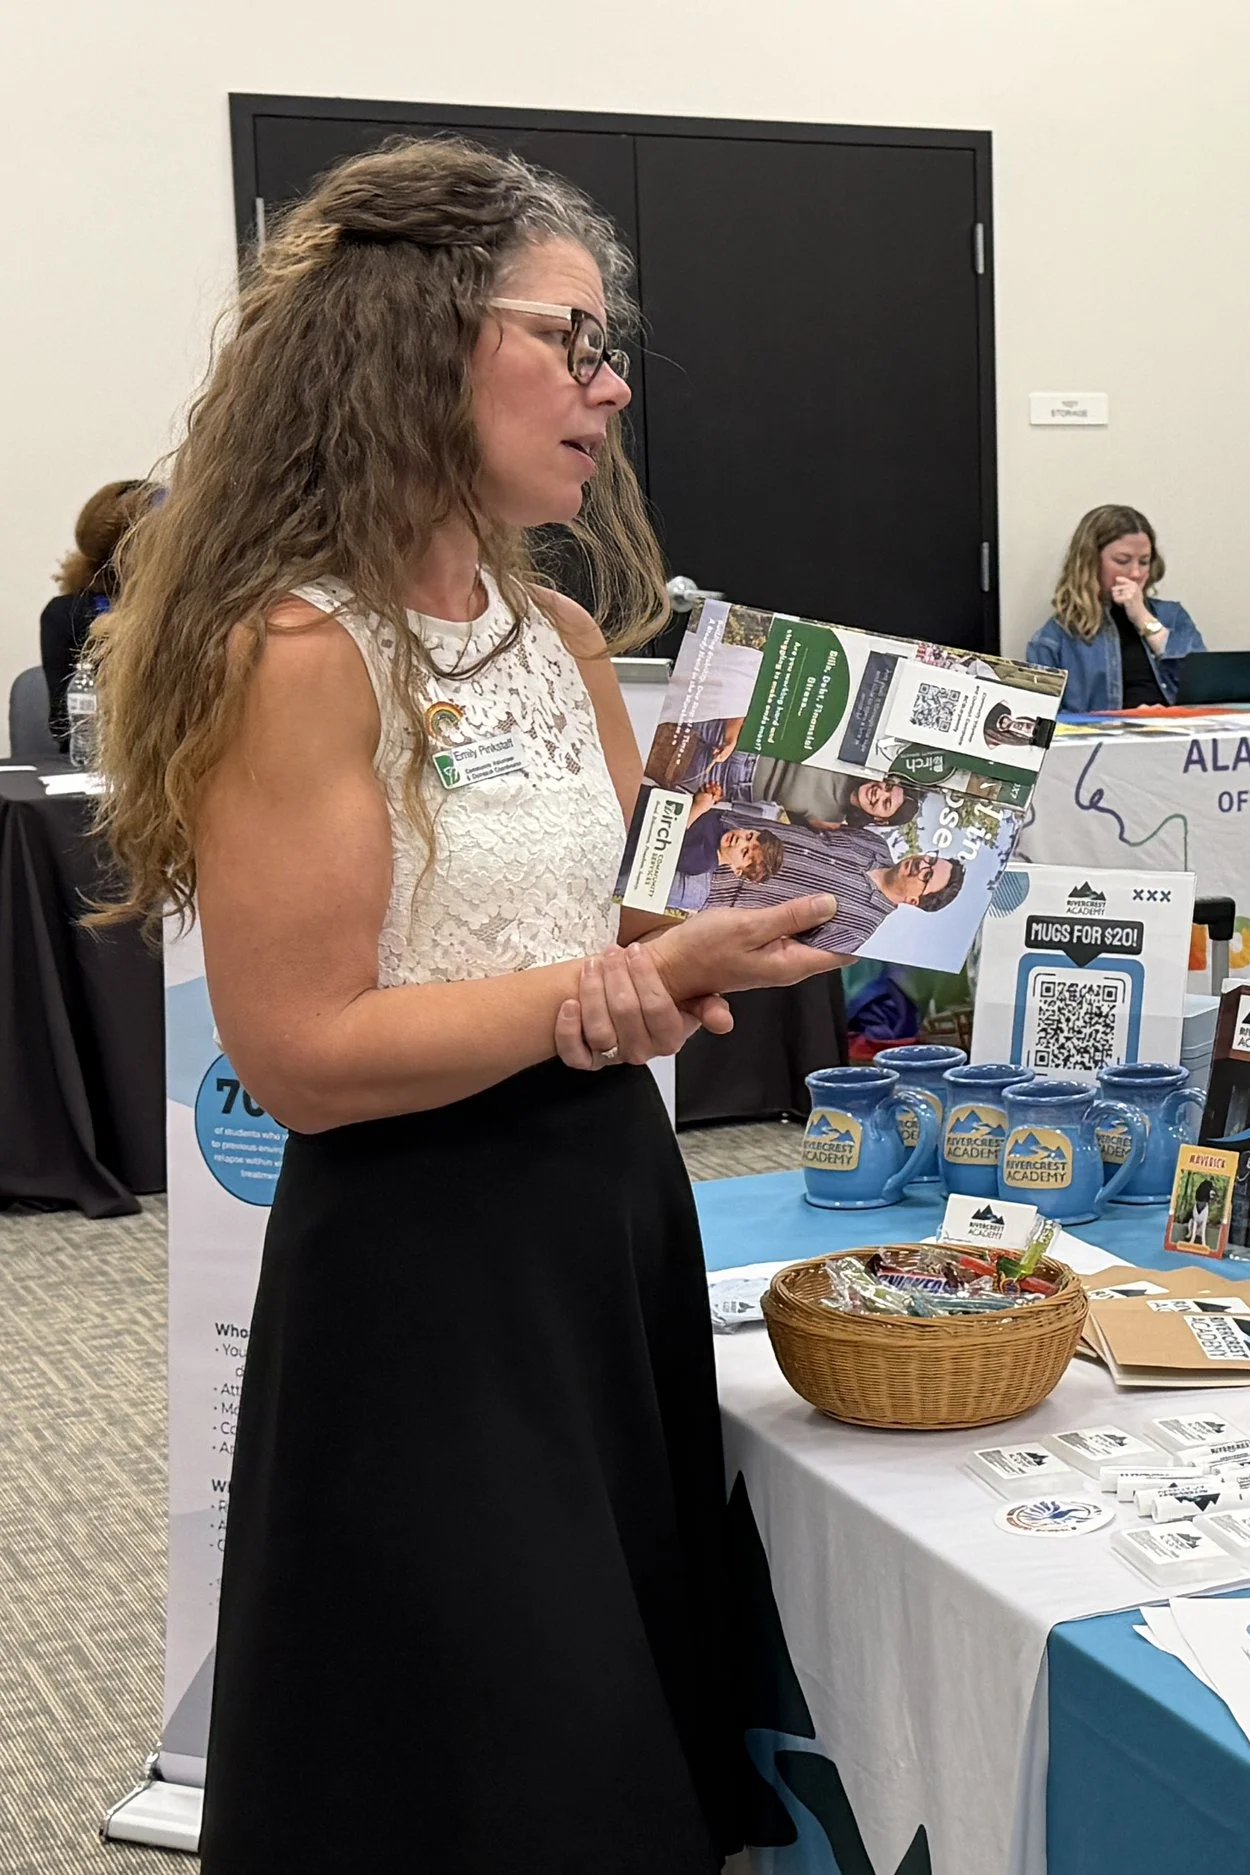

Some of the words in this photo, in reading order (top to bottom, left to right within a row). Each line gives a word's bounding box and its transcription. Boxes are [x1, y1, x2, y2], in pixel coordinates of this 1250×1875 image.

[453, 749, 477, 762] Emily
[1217, 789, 1248, 814] OF
[653, 799, 684, 852] Birch
[1066, 900, 1106, 909] RIVERCREST
[1066, 907, 1105, 916] ACADEMY
[1030, 923, 1070, 943] MUGS
[1073, 925, 1102, 944] FOR
[1104, 928, 1139, 948] $20!
[214, 1127, 223, 1135] of
[224, 1128, 261, 1139] students
[211, 1140, 221, 1148] to
[1006, 1160, 1066, 1172] RIVERCREST
[1006, 1169, 1066, 1184] ACADEMY
[1190, 1317, 1228, 1360] ACADEMY
[1209, 1316, 1250, 1359] RIVERCREST
